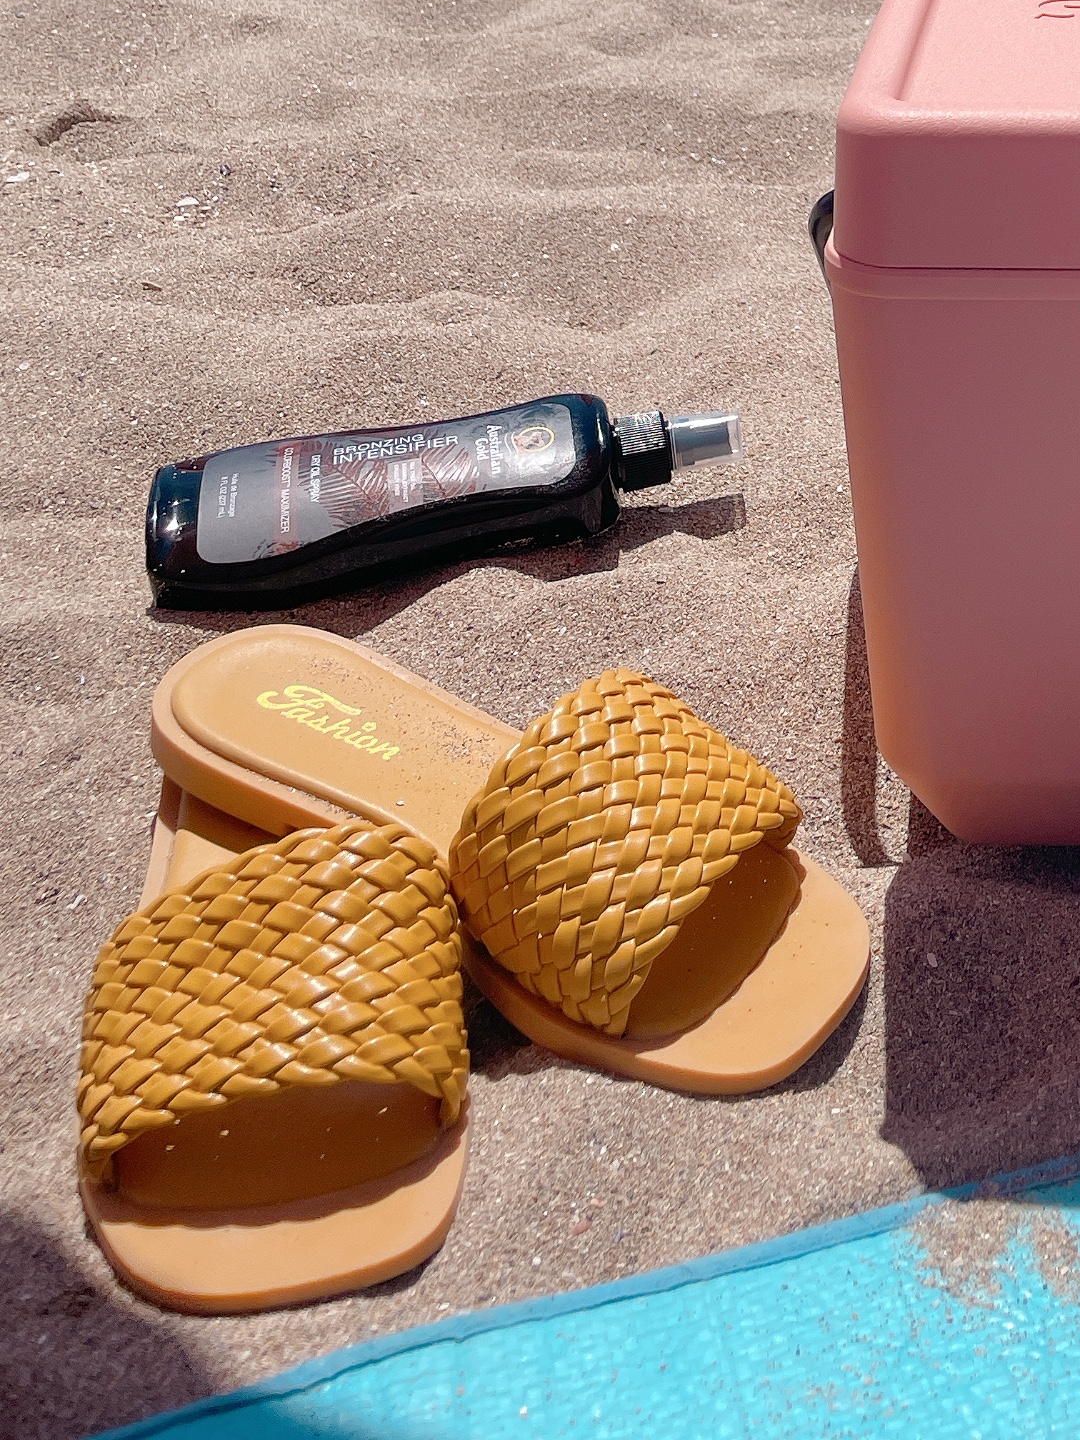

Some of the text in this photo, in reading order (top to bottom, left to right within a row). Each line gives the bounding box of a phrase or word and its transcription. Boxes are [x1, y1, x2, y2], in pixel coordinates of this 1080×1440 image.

[333, 433, 424, 456] BRONZING
[333, 435, 459, 465] INTENSIFIER
[475, 438, 490, 461] Gold
[486, 425, 504, 475] Australian
[310, 479, 321, 503] SPRAY
[280, 488, 291, 534] MAXIMIZER
[256, 684, 402, 762] Fashion
